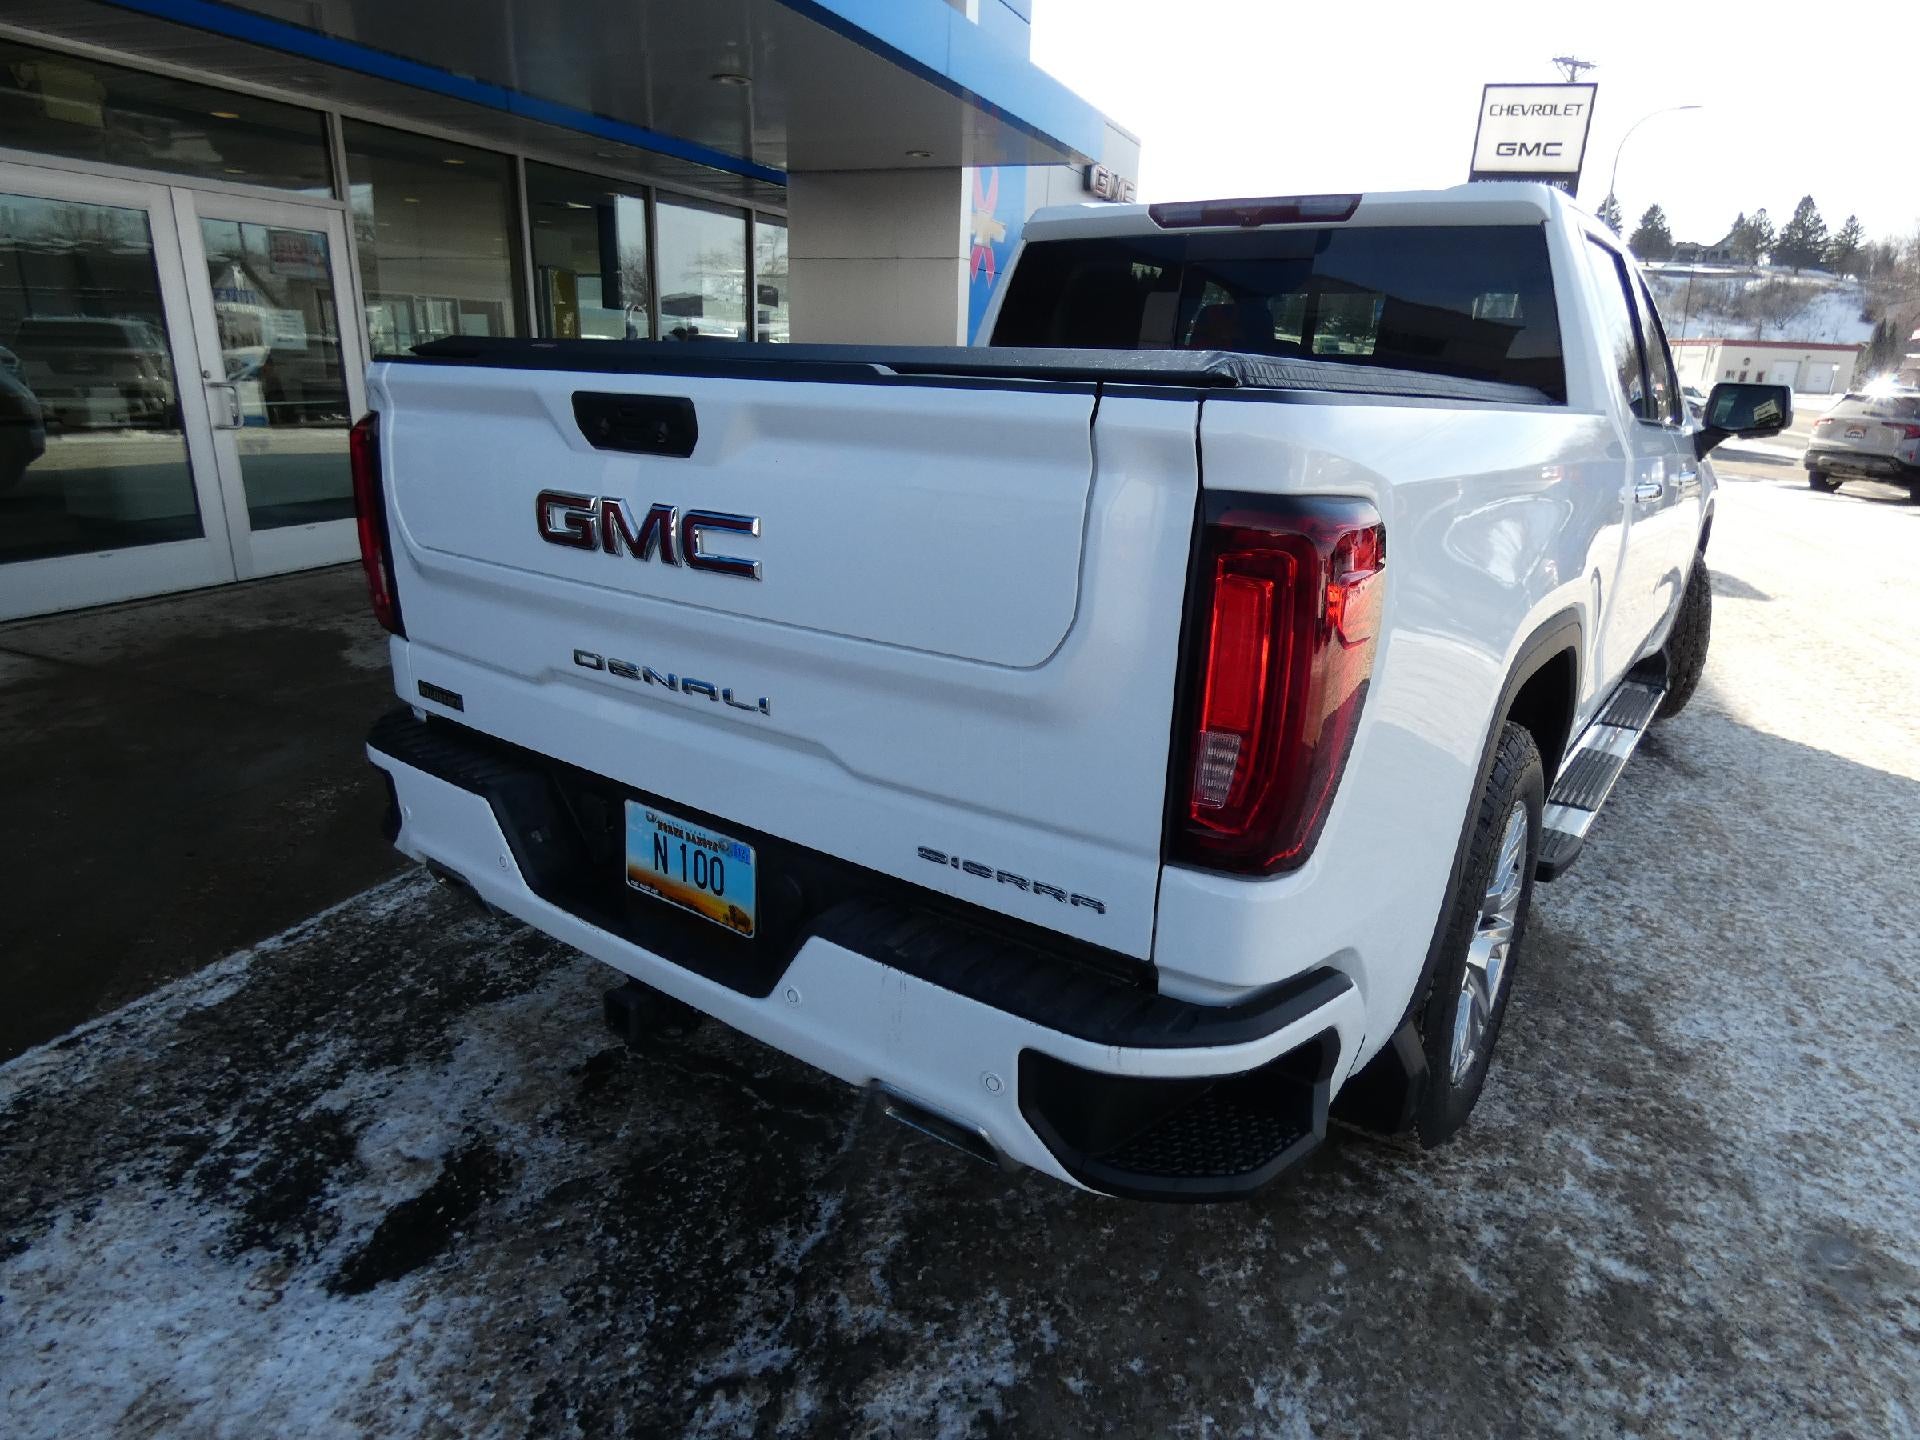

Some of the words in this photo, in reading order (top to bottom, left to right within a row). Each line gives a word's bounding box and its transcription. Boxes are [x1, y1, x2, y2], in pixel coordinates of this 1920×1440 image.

[1489, 104, 1583, 117] CHEVROLET
[1496, 142, 1562, 156] GMC
[535, 488, 762, 581] GMC
[573, 648, 771, 716] DENALI
[917, 845, 1107, 915] SIERRA
